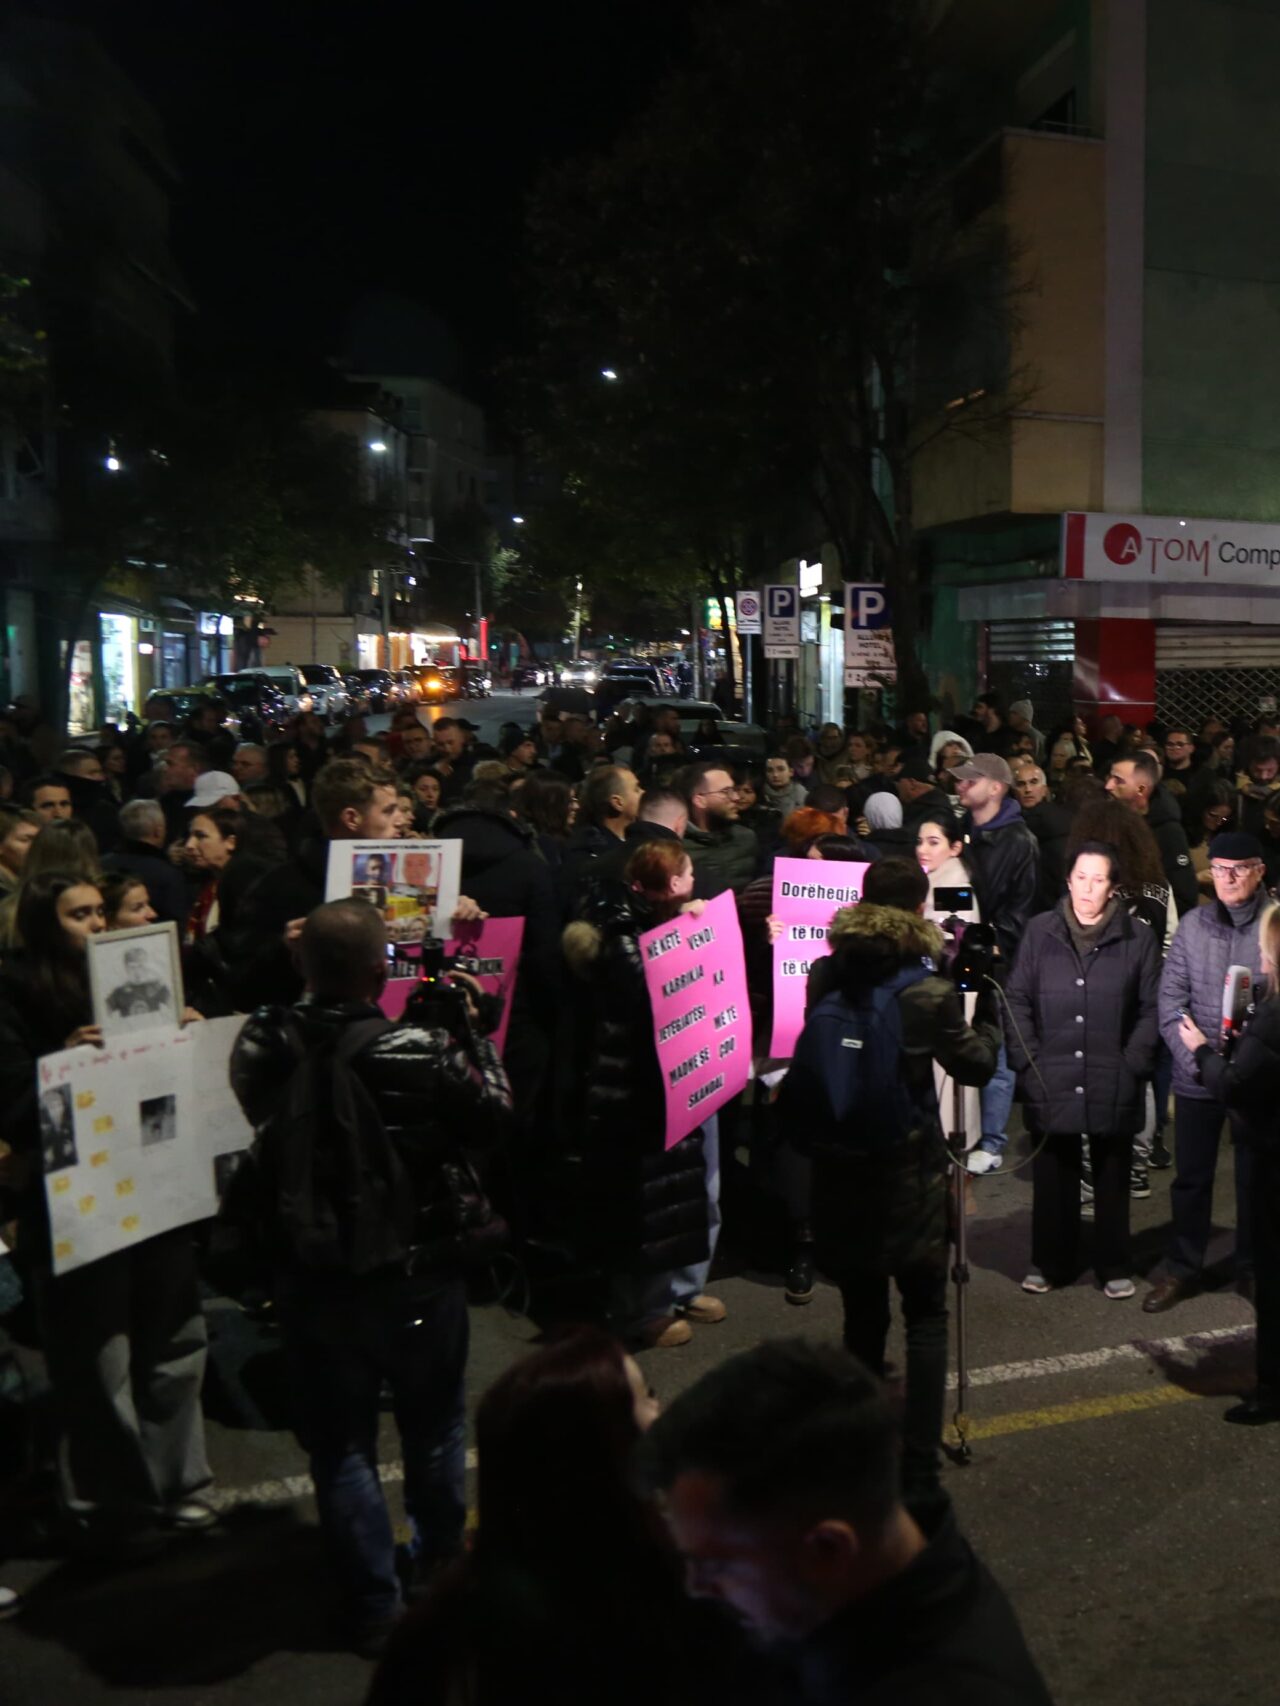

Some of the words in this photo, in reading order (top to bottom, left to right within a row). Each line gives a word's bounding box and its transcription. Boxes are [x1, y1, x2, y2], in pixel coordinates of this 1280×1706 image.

[1120, 535, 1211, 576] ATOM
[772, 589, 791, 616] P
[858, 590, 886, 627] P
[792, 925, 807, 940] të
[783, 959, 797, 975] të
[687, 1074, 723, 1109] SKANDAL
